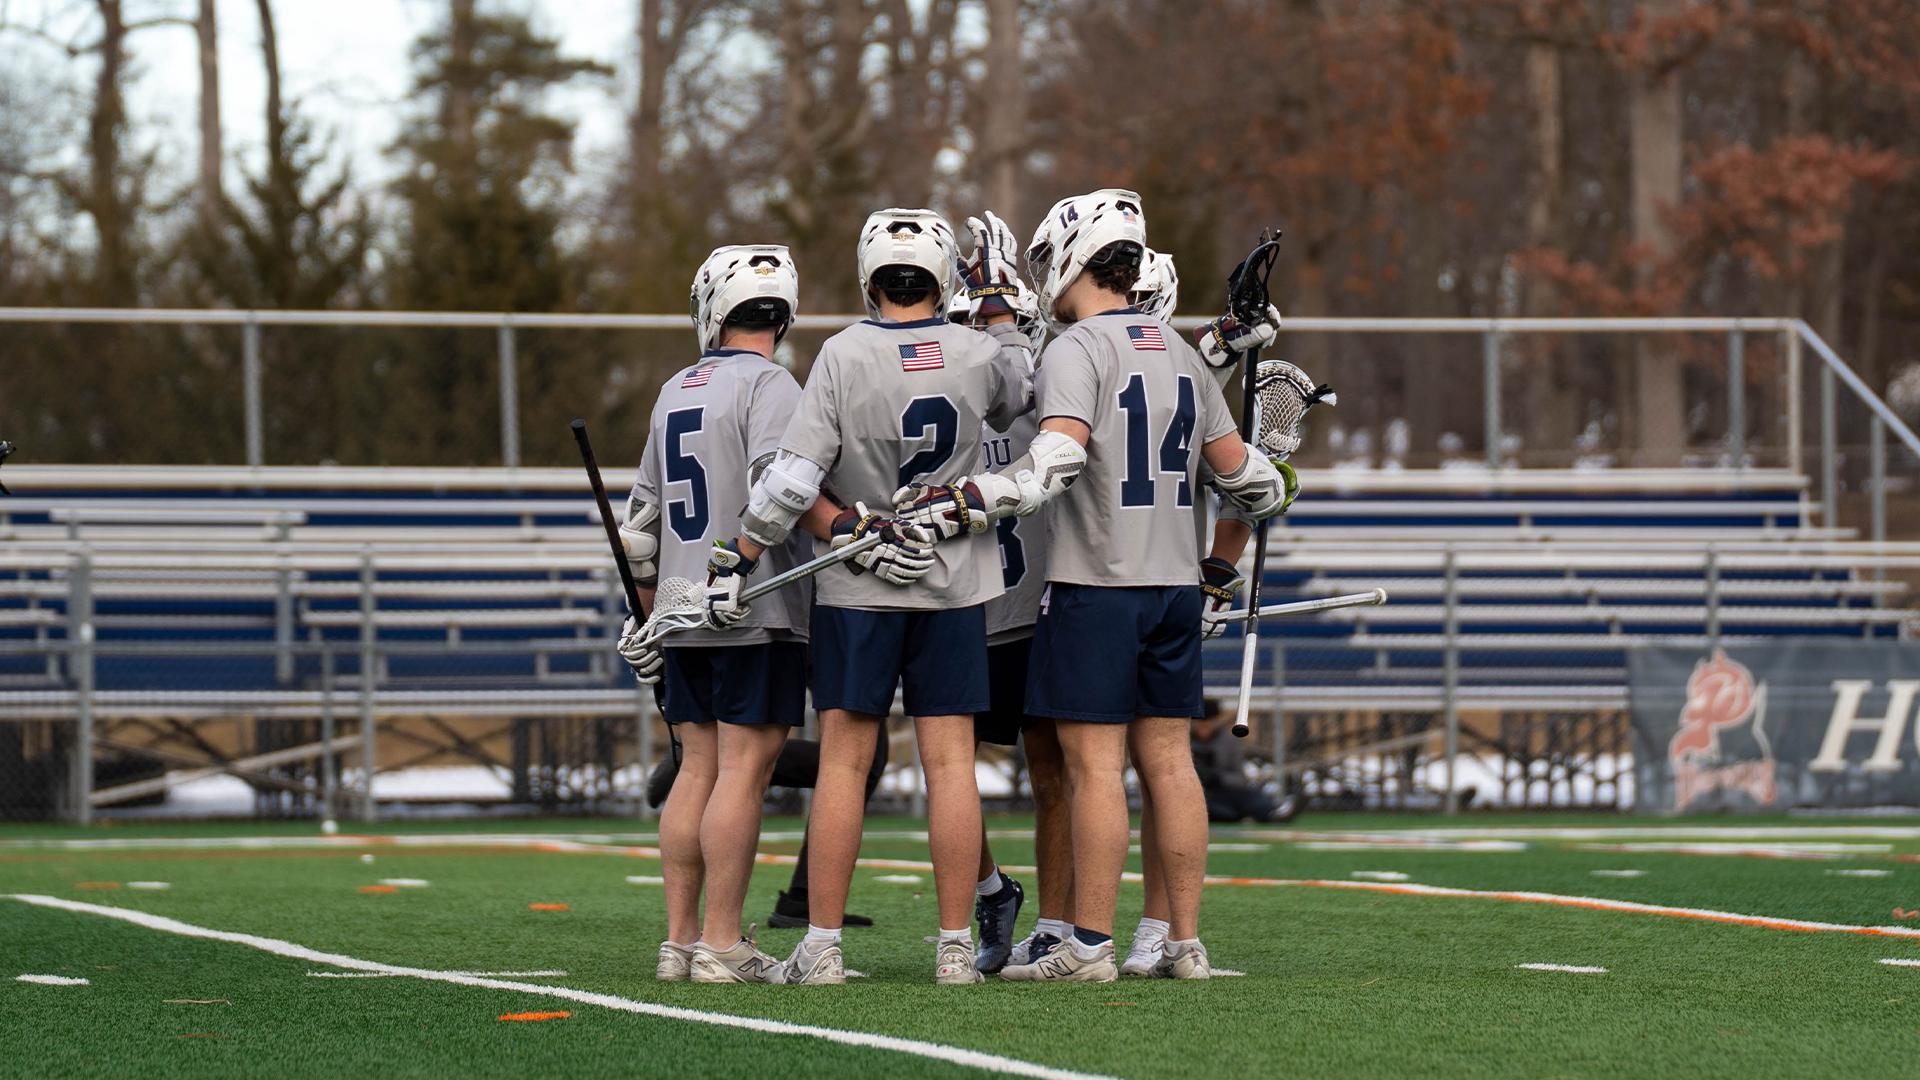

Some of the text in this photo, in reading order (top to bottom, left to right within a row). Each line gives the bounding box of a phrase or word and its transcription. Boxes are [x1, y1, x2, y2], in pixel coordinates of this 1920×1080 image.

[1059, 205, 1079, 230] 14
[663, 404, 711, 544] 5
[899, 393, 960, 489] 2
[1115, 371, 1198, 510] 14
[781, 487, 809, 506] STX
[1807, 679, 1920, 772] H
